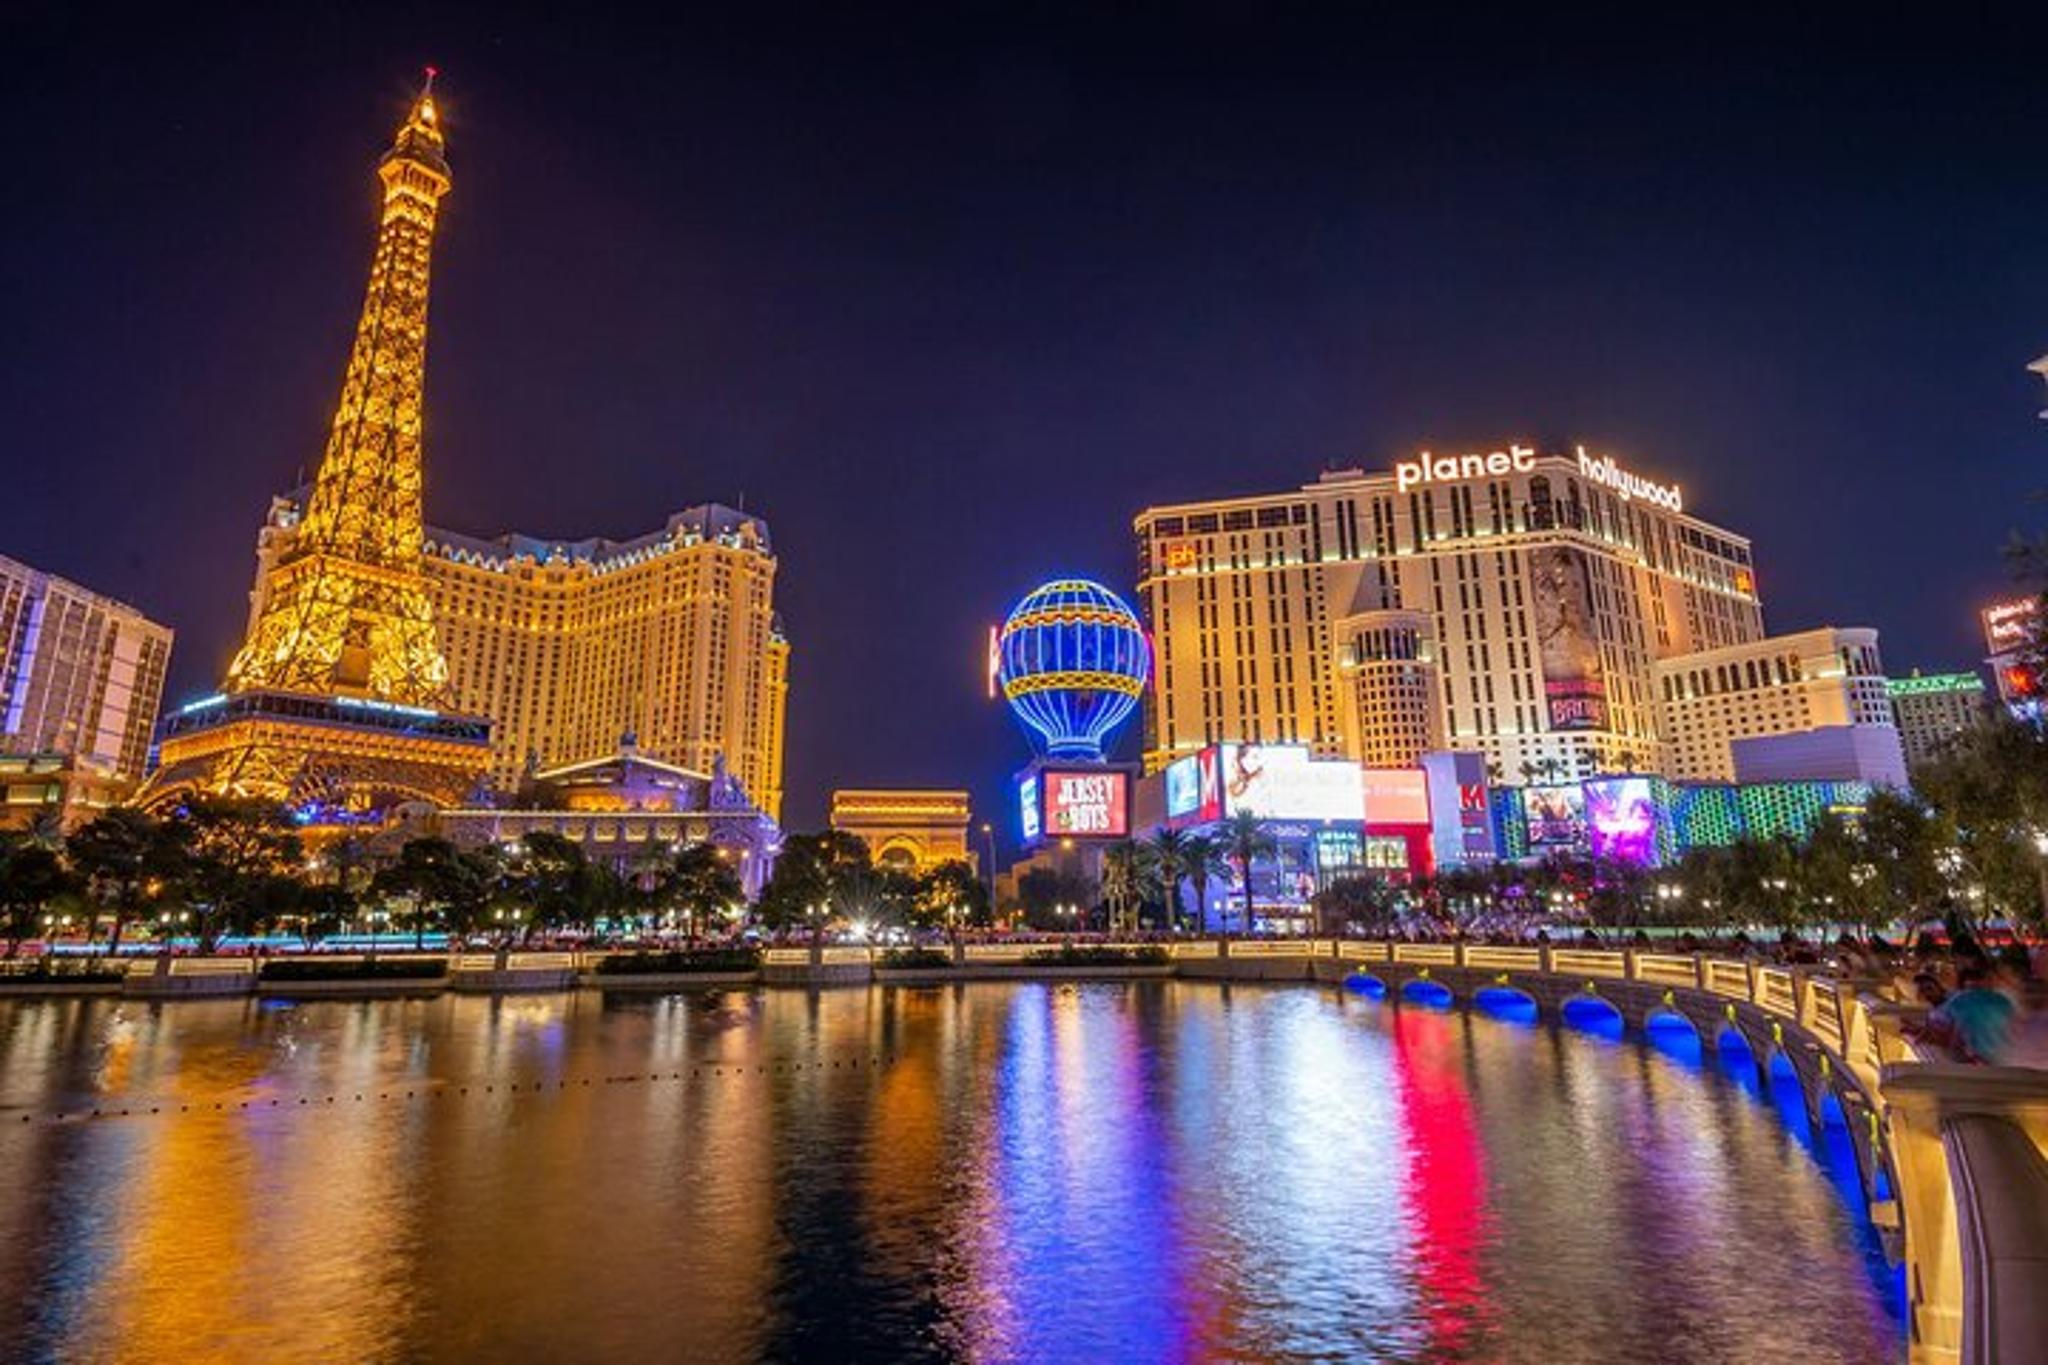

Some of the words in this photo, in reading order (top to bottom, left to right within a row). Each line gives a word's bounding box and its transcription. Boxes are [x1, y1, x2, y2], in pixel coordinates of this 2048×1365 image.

[1397, 446, 1535, 492] planet
[1577, 446, 1682, 512] hollywood
[1058, 776, 1114, 805] JERSEY
